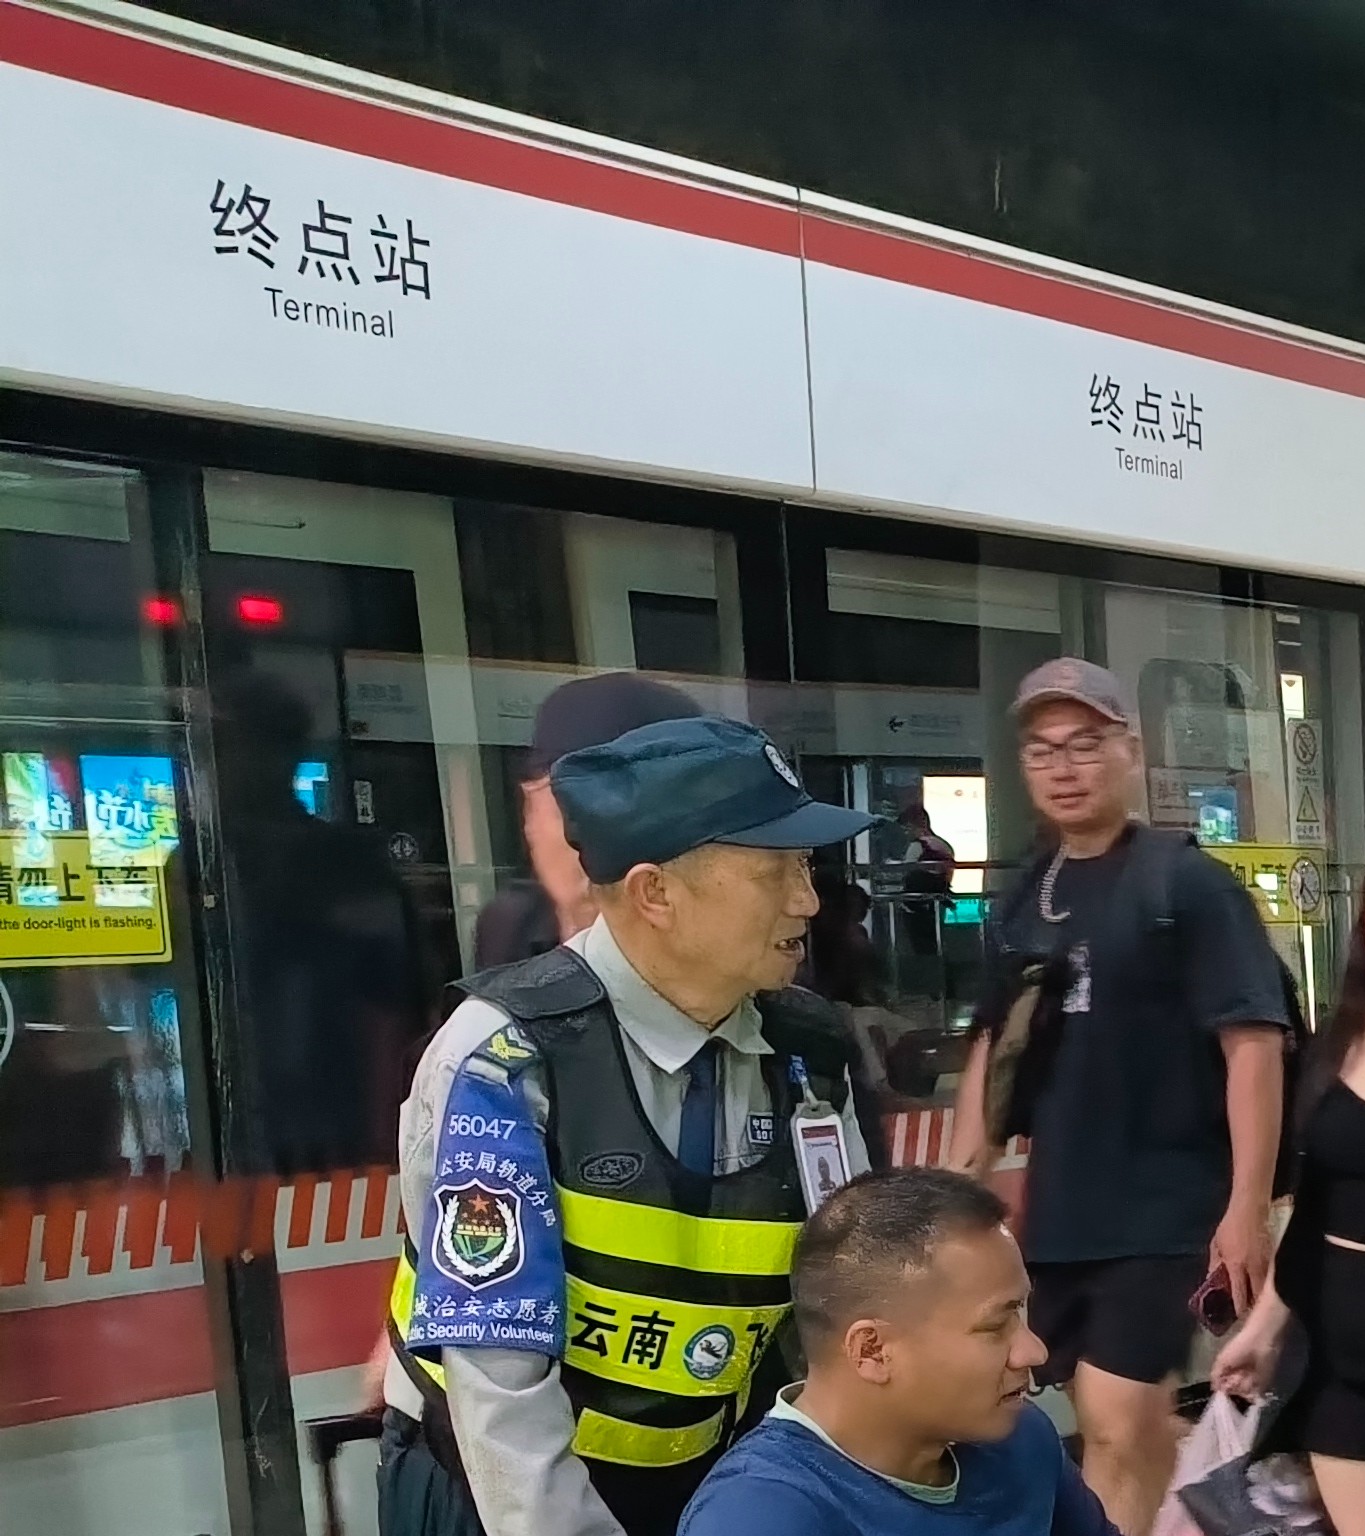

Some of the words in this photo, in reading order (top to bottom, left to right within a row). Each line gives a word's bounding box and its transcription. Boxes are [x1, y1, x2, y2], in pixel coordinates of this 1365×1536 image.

[209, 178, 433, 301] 终点站
[263, 286, 396, 339] Terminal
[1088, 373, 1204, 451] 终点站
[1115, 447, 1183, 480] Terminal
[23, 916, 87, 932] door-light
[89, 917, 100, 929] is
[103, 916, 157, 931] flashing.
[449, 1114, 517, 1140] 56047
[427, 1322, 486, 1341] Security
[490, 1322, 555, 1344] Volunteer
[571, 1302, 675, 1370] 云南
